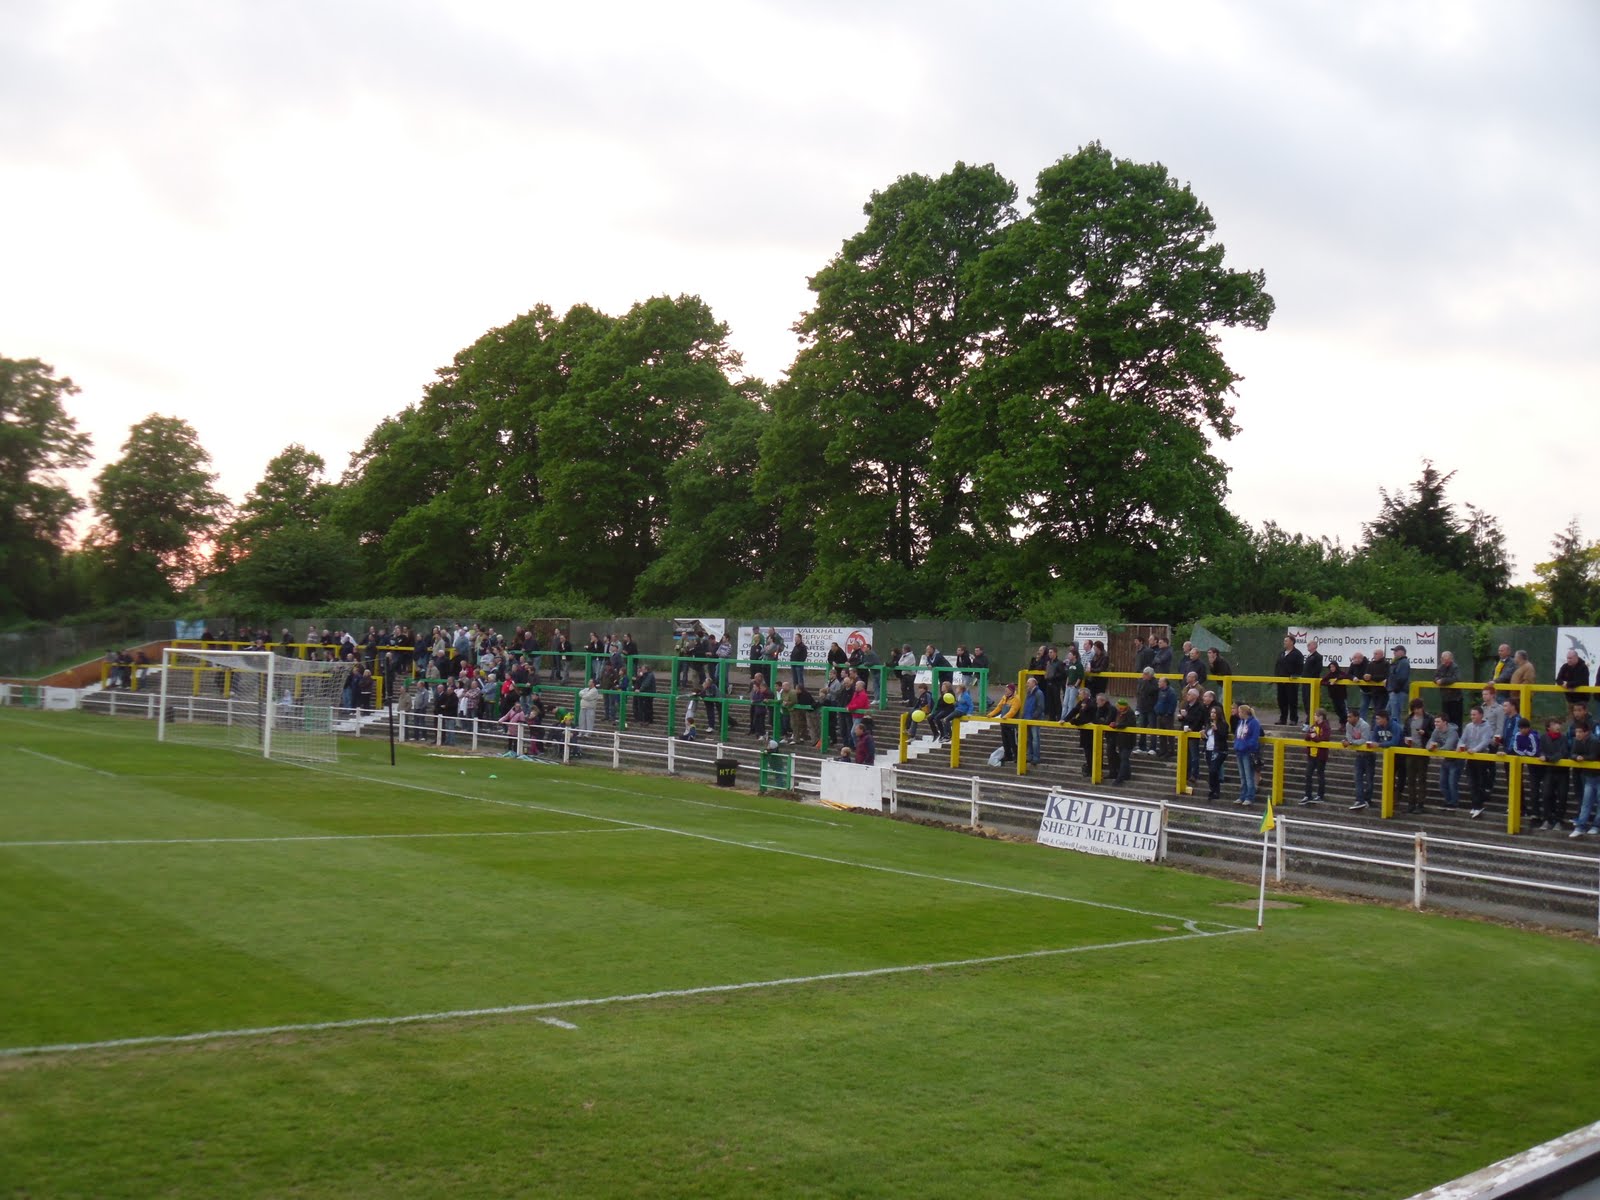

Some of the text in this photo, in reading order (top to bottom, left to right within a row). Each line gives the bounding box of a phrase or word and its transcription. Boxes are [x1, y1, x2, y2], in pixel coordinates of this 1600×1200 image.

[1313, 636, 1411, 646] Opening Doors For Hitchin
[1044, 795, 1159, 836] KELPHIL
[1041, 820, 1157, 852] SHEET METAL LTD
